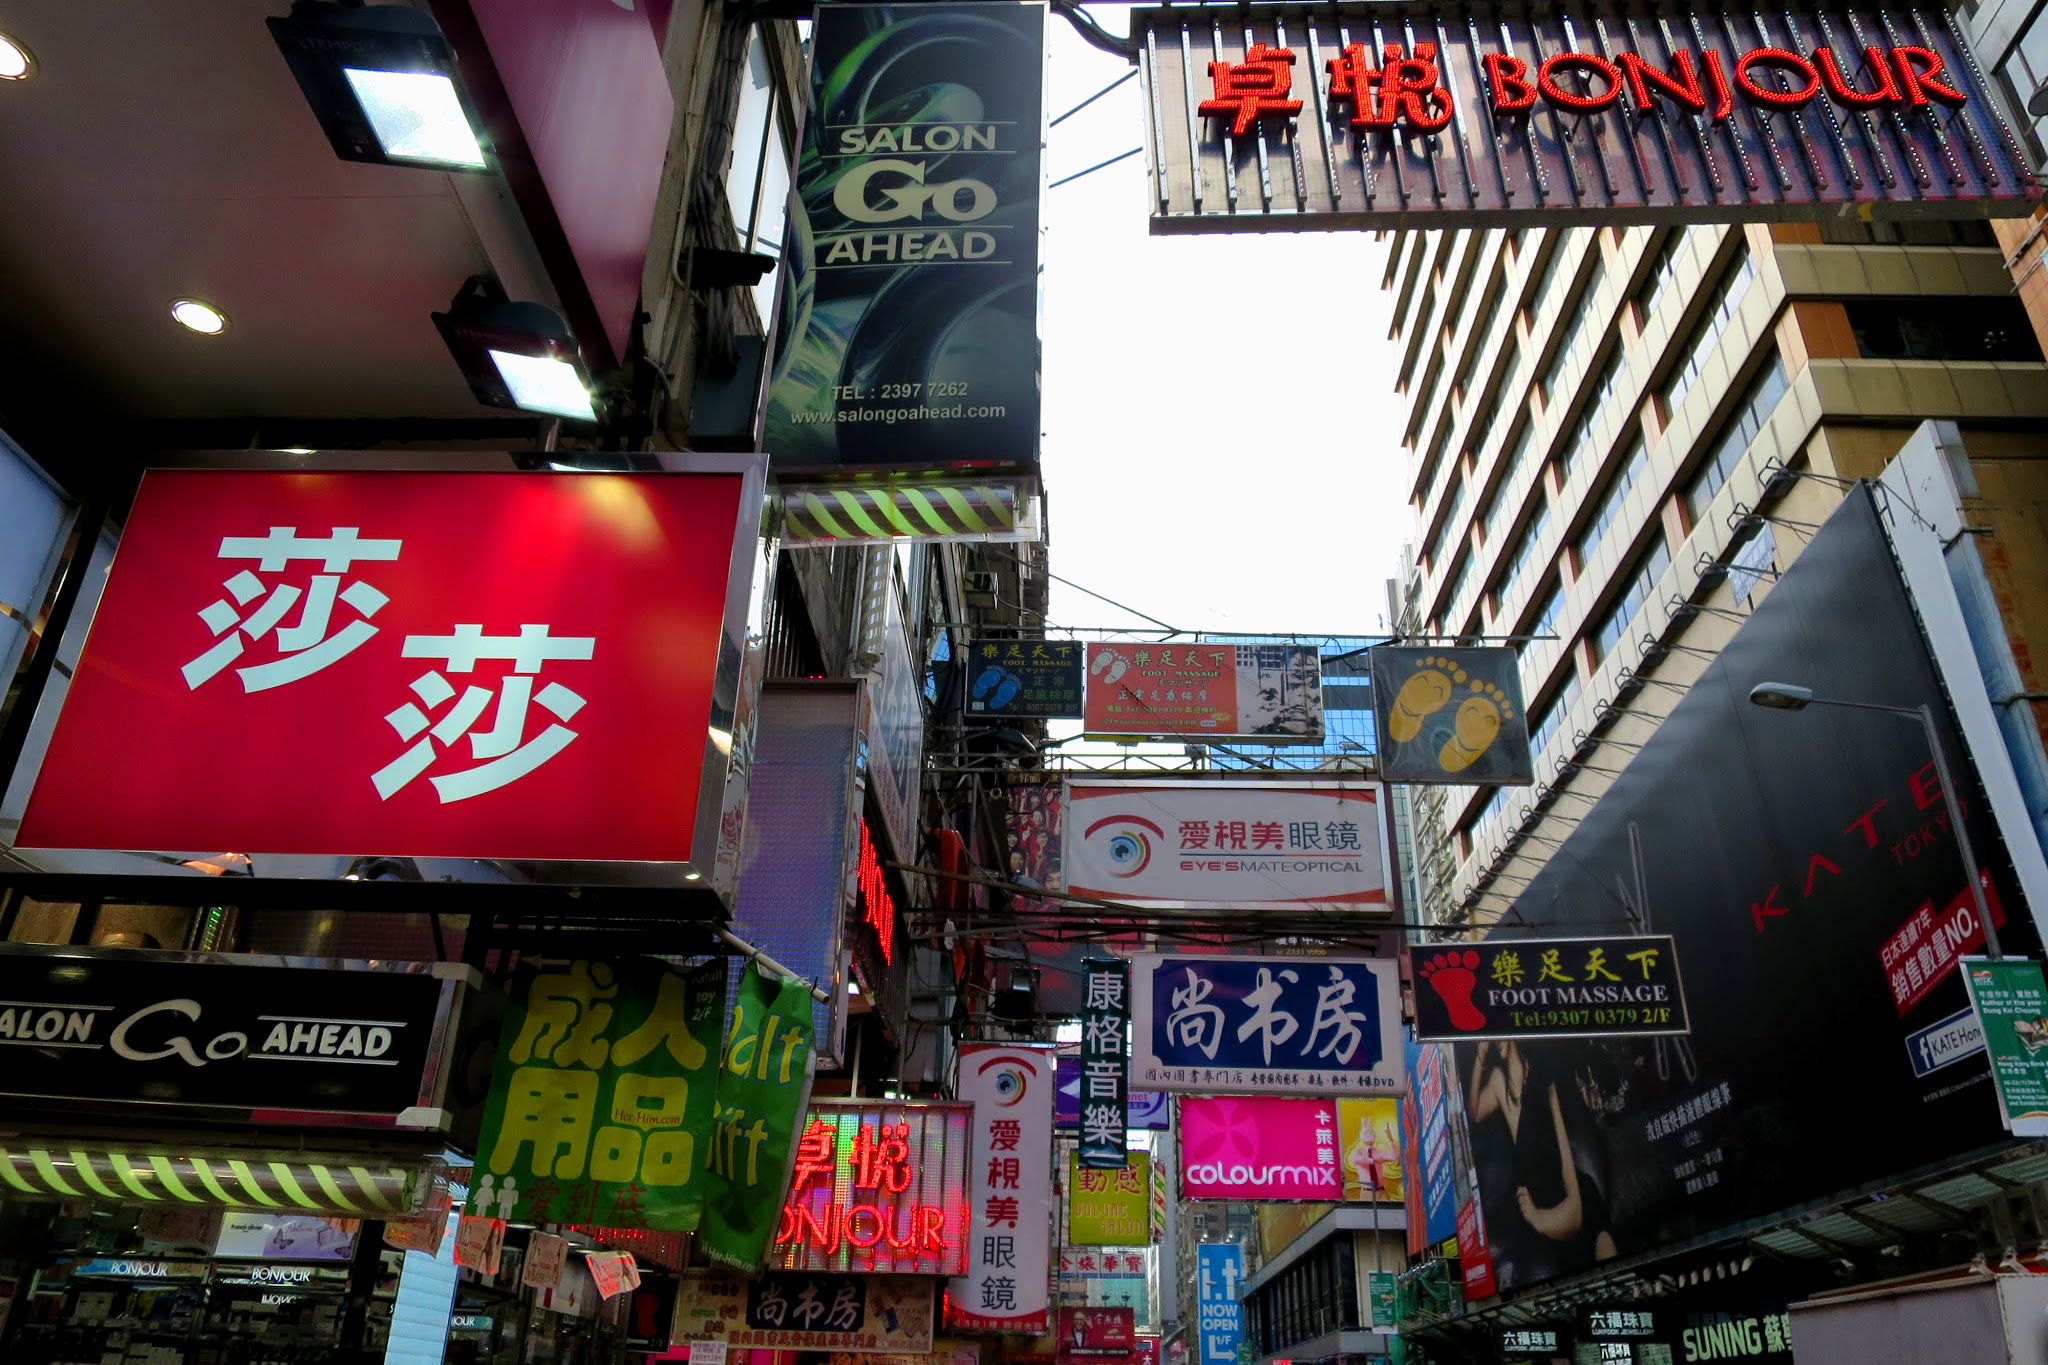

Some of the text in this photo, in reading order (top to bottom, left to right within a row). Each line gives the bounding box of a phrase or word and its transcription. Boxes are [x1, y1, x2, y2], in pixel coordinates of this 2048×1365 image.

[1482, 46, 1966, 128] BONJOUR
[839, 125, 996, 153] SALON
[834, 159, 997, 223] Go
[825, 231, 996, 263] AHEAD
[832, 385, 865, 400] TEL
[881, 384, 921, 398] 2397
[928, 382, 968, 397] 7262
[790, 404, 1005, 424] www.salongoahead.com
[981, 644, 1073, 659] 樂足天下
[1133, 649, 1227, 668] 樂足天下
[181, 526, 596, 804] 莎莎
[1141, 670, 1221, 678] FOOT MASSAGE
[1117, 689, 1209, 703] 正宗足底按摩
[1178, 820, 1362, 850] 愛視美眼鏡
[1881, 908, 1932, 969] 日本連續7年
[1490, 948, 1659, 987] 樂足天下
[1488, 985, 1668, 1007] FOOT MASSAGE
[1595, 1008, 1637, 1024] 0379
[1642, 1007, 1671, 1023] 2/F
[110, 999, 248, 1067] Go
[262, 1022, 392, 1056] AHEAD
[1084, 971, 1124, 1145] 康格音樂
[614, 1109, 680, 1125] Her-Him.com
[1315, 1109, 1335, 1165] 卡萊美
[980, 1119, 1022, 1312] 愛視美眼鏡
[110, 1262, 167, 1277] BONJOUR
[252, 1268, 310, 1282] BONJOUR
[1201, 1258, 1239, 1300] i.t
[1202, 1304, 1239, 1317] NOW
[1201, 1319, 1239, 1331] OPEN
[1215, 1335, 1232, 1345] 1/F
[1683, 1319, 1760, 1362] SUNING
